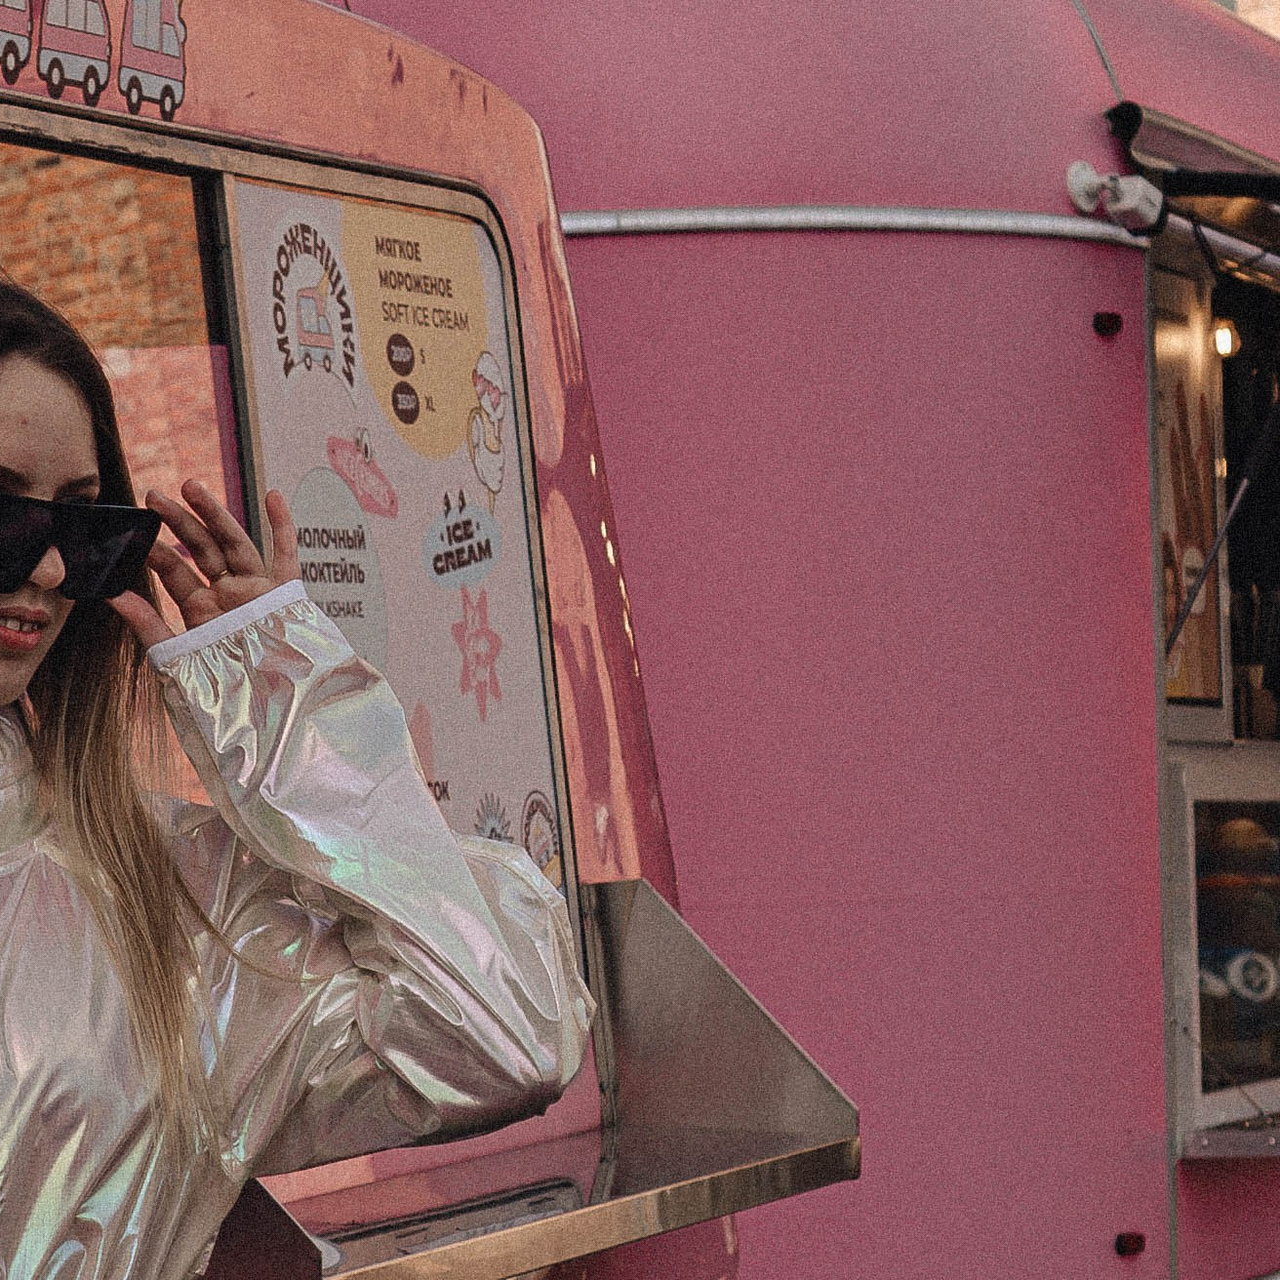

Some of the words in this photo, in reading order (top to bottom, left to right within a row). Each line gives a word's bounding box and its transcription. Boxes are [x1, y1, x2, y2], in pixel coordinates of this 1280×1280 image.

[375, 236, 422, 262] МЯГКОЕ
[378, 269, 454, 299] МОРОЖЕНОЕ
[273, 223, 356, 388] МОРОЖЕНЩИКИ
[382, 301, 410, 322] SOFT
[412, 305, 430, 328] ICE
[432, 308, 470, 333] CREAM
[446, 519, 474, 546] ICE
[300, 557, 366, 584] КОКТЕЙЛЬ
[432, 538, 493, 576] CREAM
